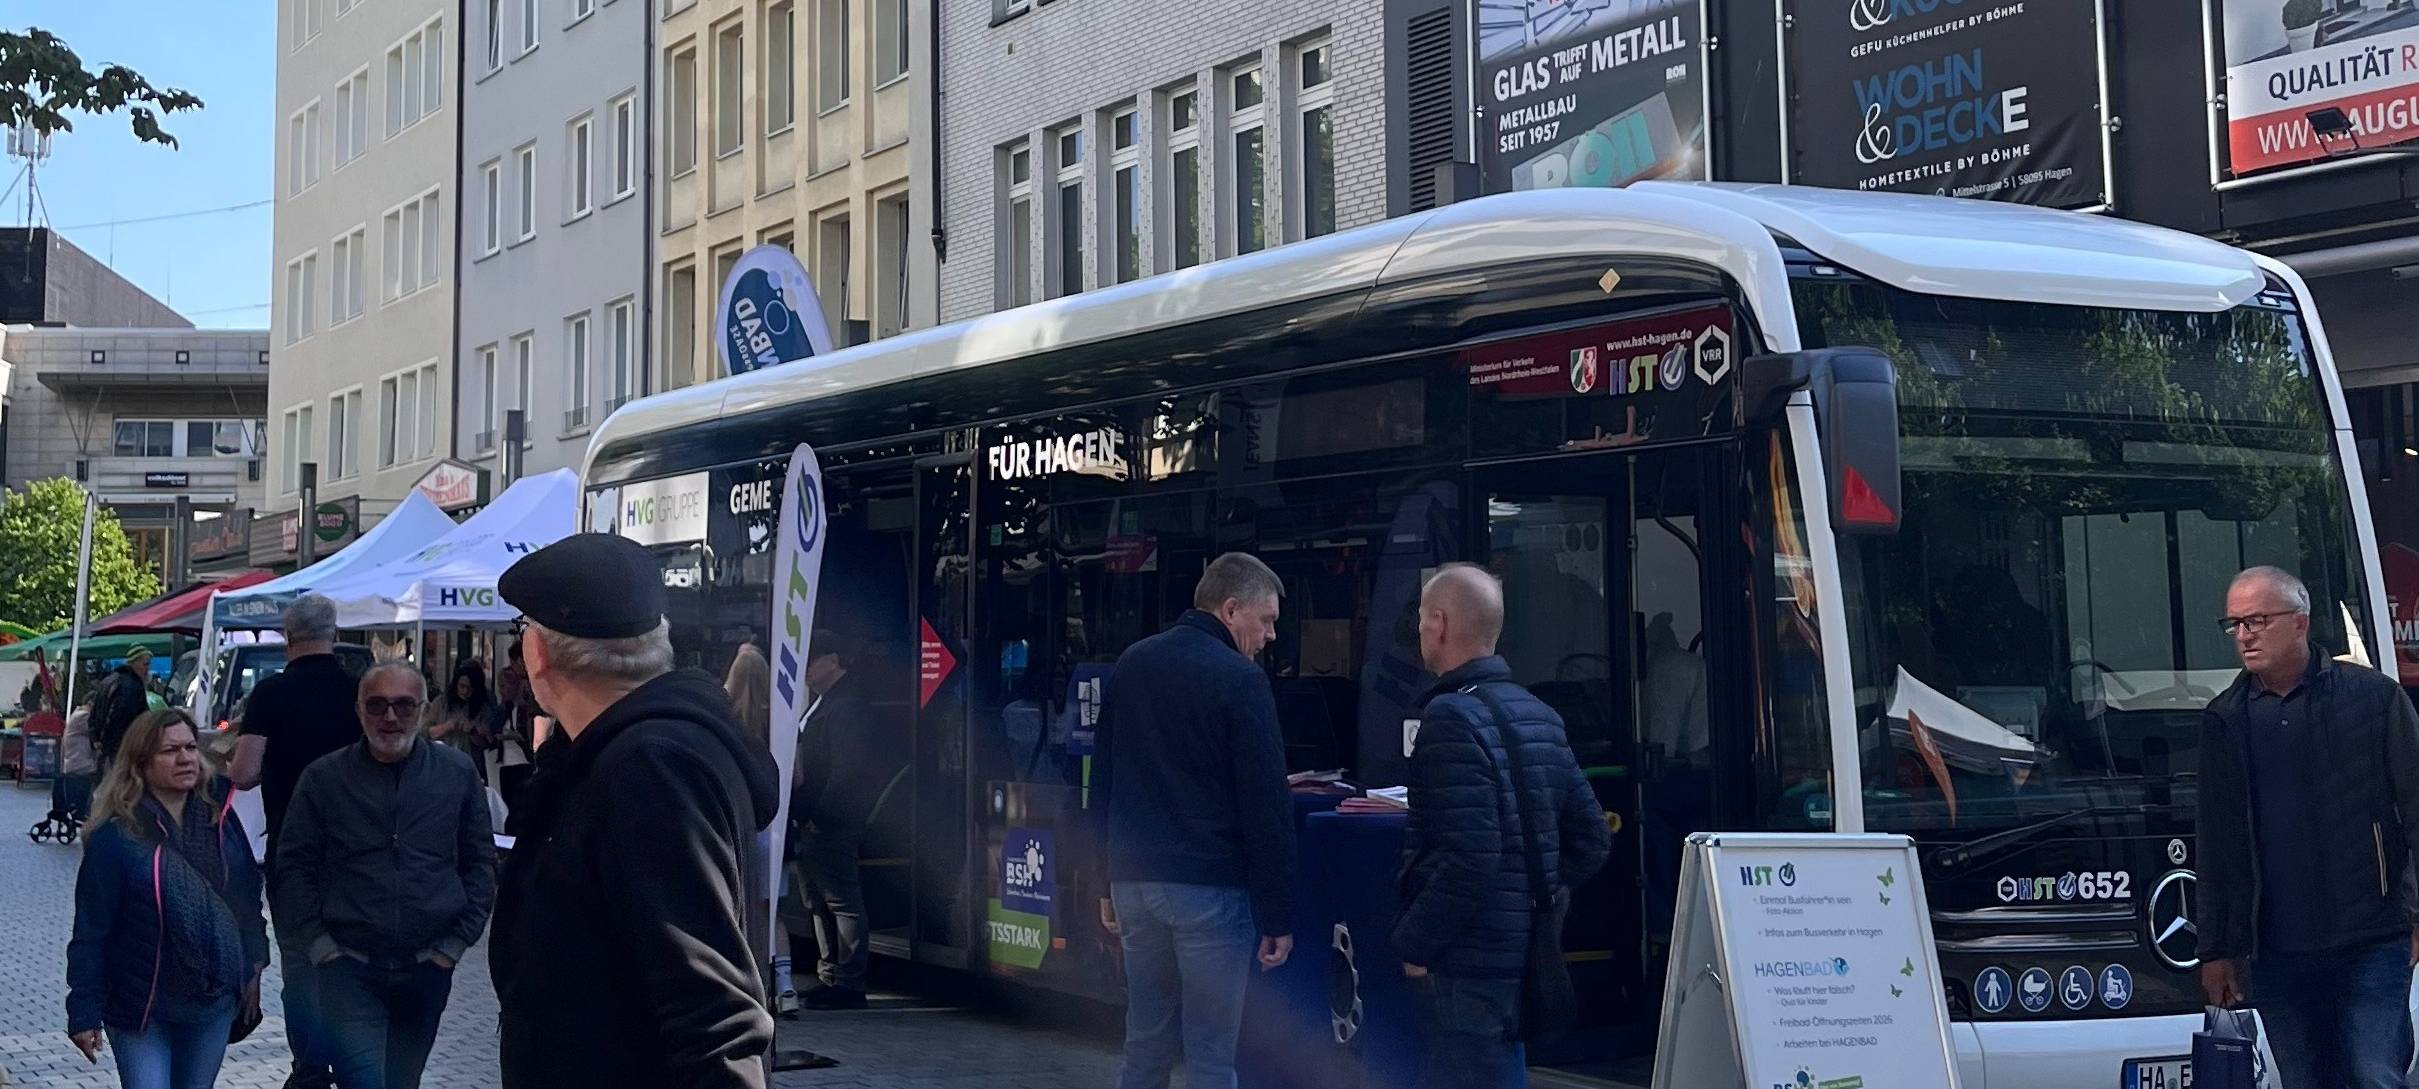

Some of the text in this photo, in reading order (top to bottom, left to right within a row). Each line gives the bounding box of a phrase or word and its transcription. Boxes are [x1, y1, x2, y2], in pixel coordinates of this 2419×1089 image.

[1850, 40, 1882, 57] GEFU
[1886, 20, 1965, 49] KÜCHENHELFER
[1968, 14, 1982, 27] BY
[1986, 2, 2024, 22] BÖHME
[1494, 16, 1686, 101] GLAS TRIFFT AUF METALL
[2268, 44, 2418, 101] QUALITÄT R
[1853, 48, 1982, 114] WOHN
[1500, 94, 1577, 131] METALLBAU
[1500, 121, 1560, 153] SEIT 1957
[1859, 144, 2031, 191] HOMETEXTILE BY BÖHME
[2044, 167, 2072, 180] Hagen
[1606, 328, 1692, 351] www.hst-hagen.de
[1609, 347, 1722, 395] HST VRR
[989, 427, 1115, 480] FÜR HAGEN
[626, 491, 700, 527] HVG GRUPPE
[440, 588, 494, 607] HVG
[777, 550, 809, 710] HST
[1006, 862, 1034, 888] BSH
[1739, 866, 1773, 887] HST
[2018, 871, 2132, 900] HST 652
[1856, 928, 1883, 939] Hagen
[1754, 961, 1833, 977] HAGENBAD
